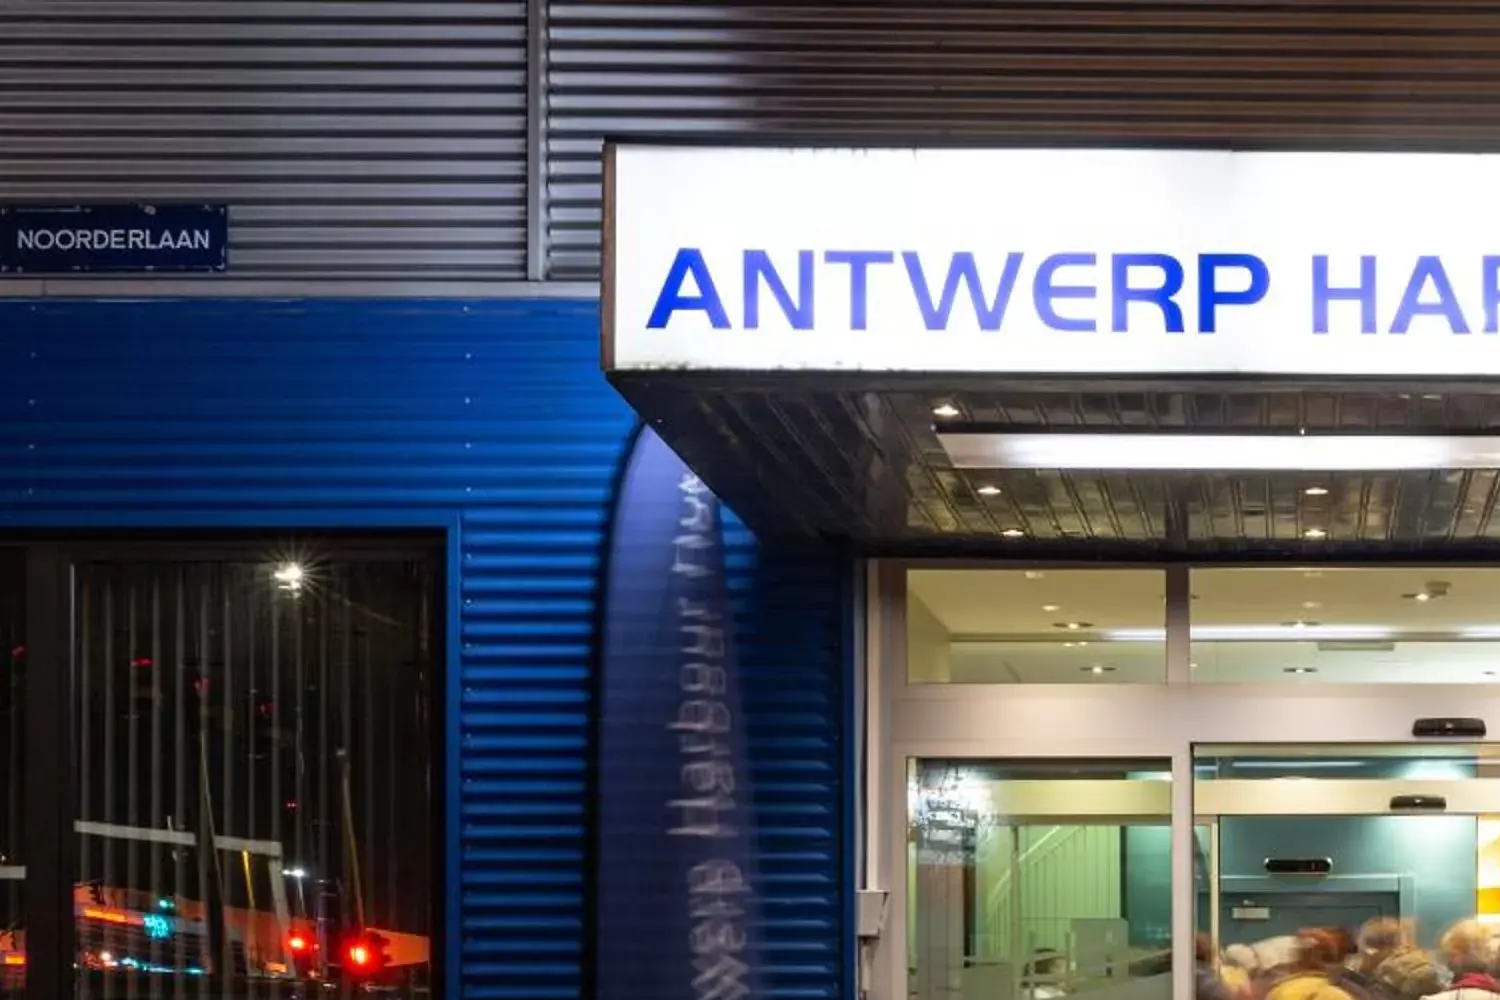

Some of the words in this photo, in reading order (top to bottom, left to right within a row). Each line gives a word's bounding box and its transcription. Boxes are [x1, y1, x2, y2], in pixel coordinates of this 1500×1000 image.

[17, 228, 210, 251] NOORDERLAAN
[646, 248, 1270, 334] ANTWERP
[665, 596, 740, 838] Harbour
